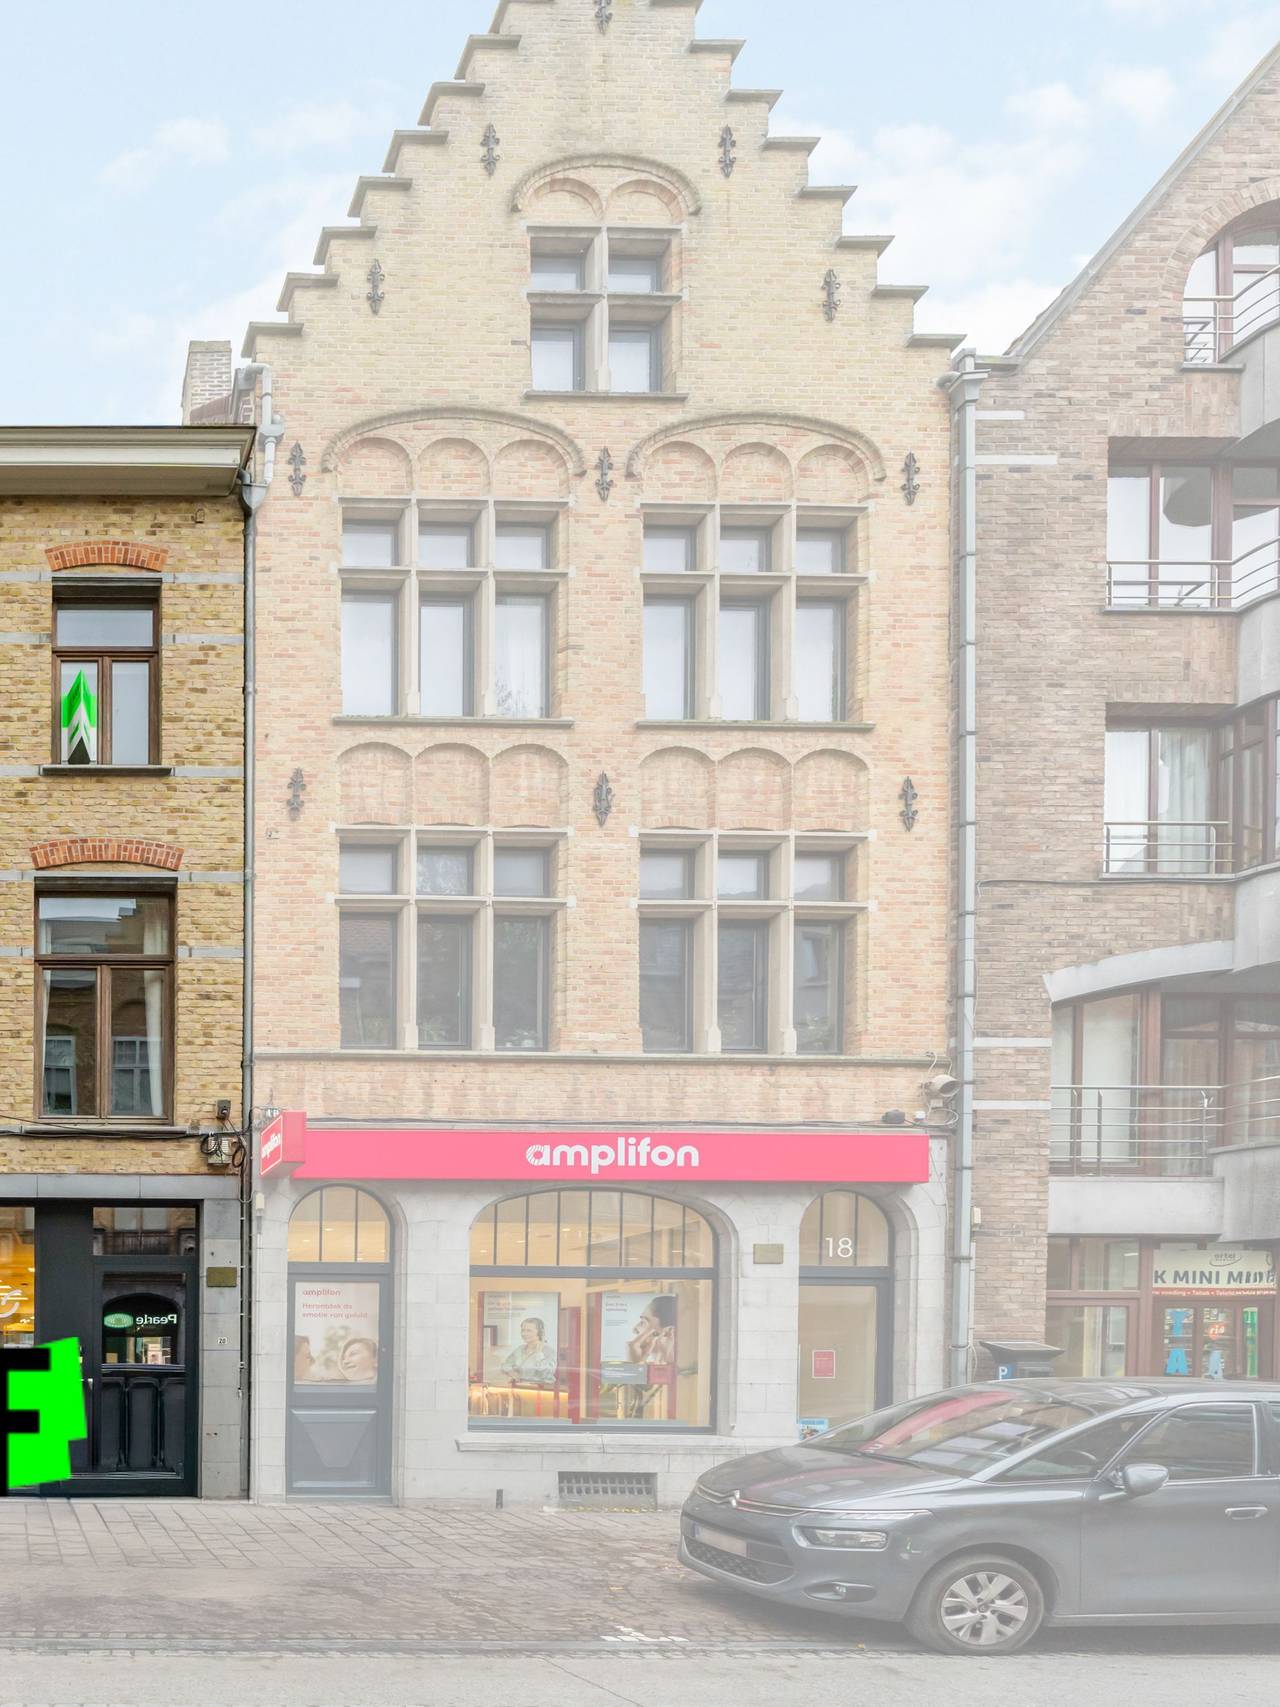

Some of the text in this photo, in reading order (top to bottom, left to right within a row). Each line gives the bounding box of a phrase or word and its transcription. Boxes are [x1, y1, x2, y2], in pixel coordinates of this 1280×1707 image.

[525, 1136, 700, 1175] amplifon
[825, 1237, 854, 1258] 18
[1153, 1269, 1168, 1284] K
[1173, 1269, 1220, 1284] MINI
[302, 1287, 342, 1298] amplifon
[999, 1366, 1008, 1381] P
